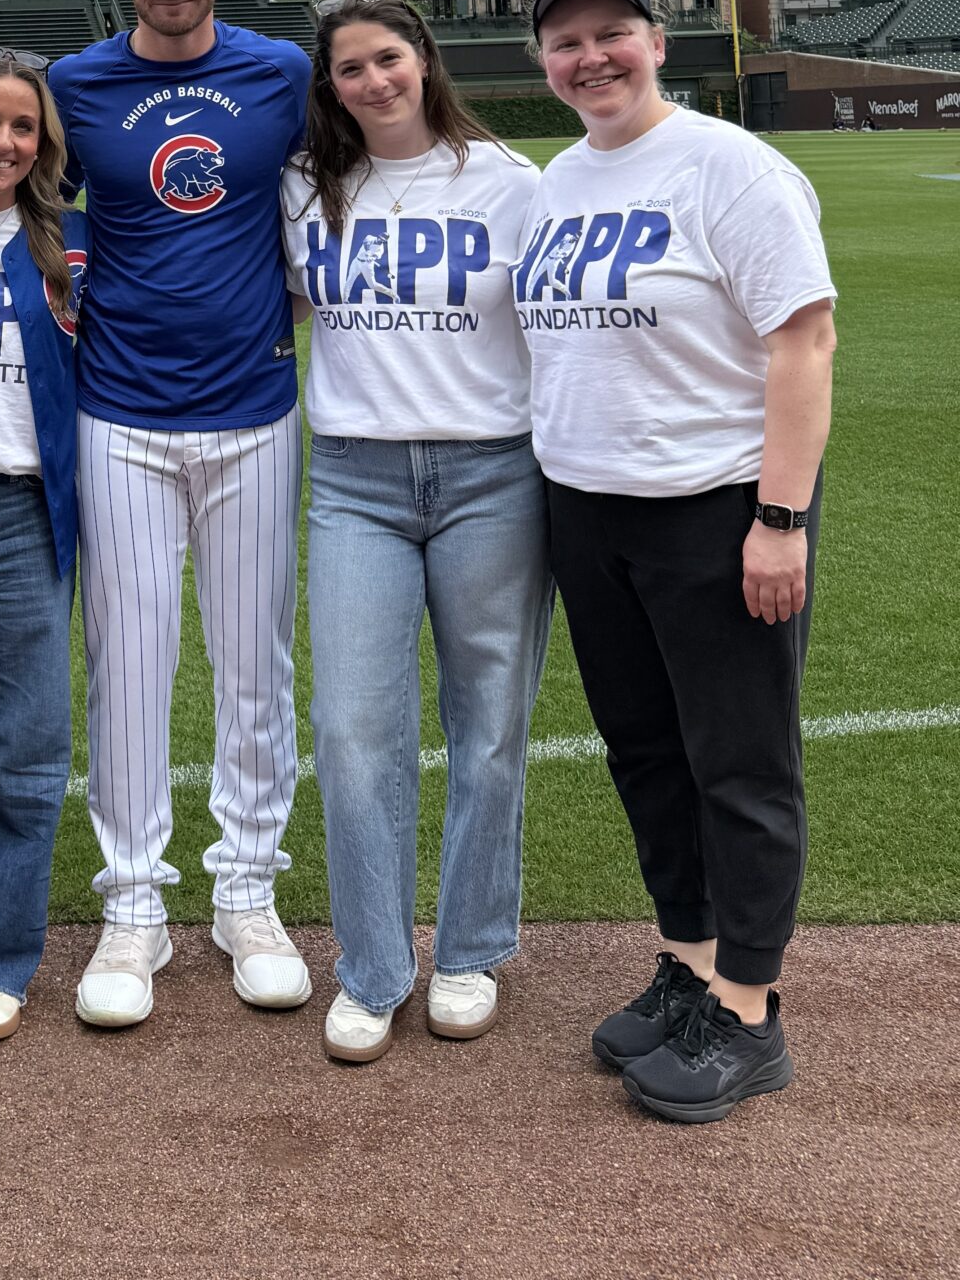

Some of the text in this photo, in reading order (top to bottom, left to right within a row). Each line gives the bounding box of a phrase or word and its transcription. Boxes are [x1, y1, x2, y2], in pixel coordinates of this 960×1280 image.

[122, 86, 242, 131] CHICAGO BASEBALL
[868, 100, 919, 118] Vienna Beef
[461, 209, 487, 218] 2025
[646, 199, 671, 207] 2025
[306, 218, 490, 306] HAPP
[507, 209, 671, 303] HAPP
[318, 310, 478, 332] FOUNDATION
[518, 306, 658, 330] UNDATION
